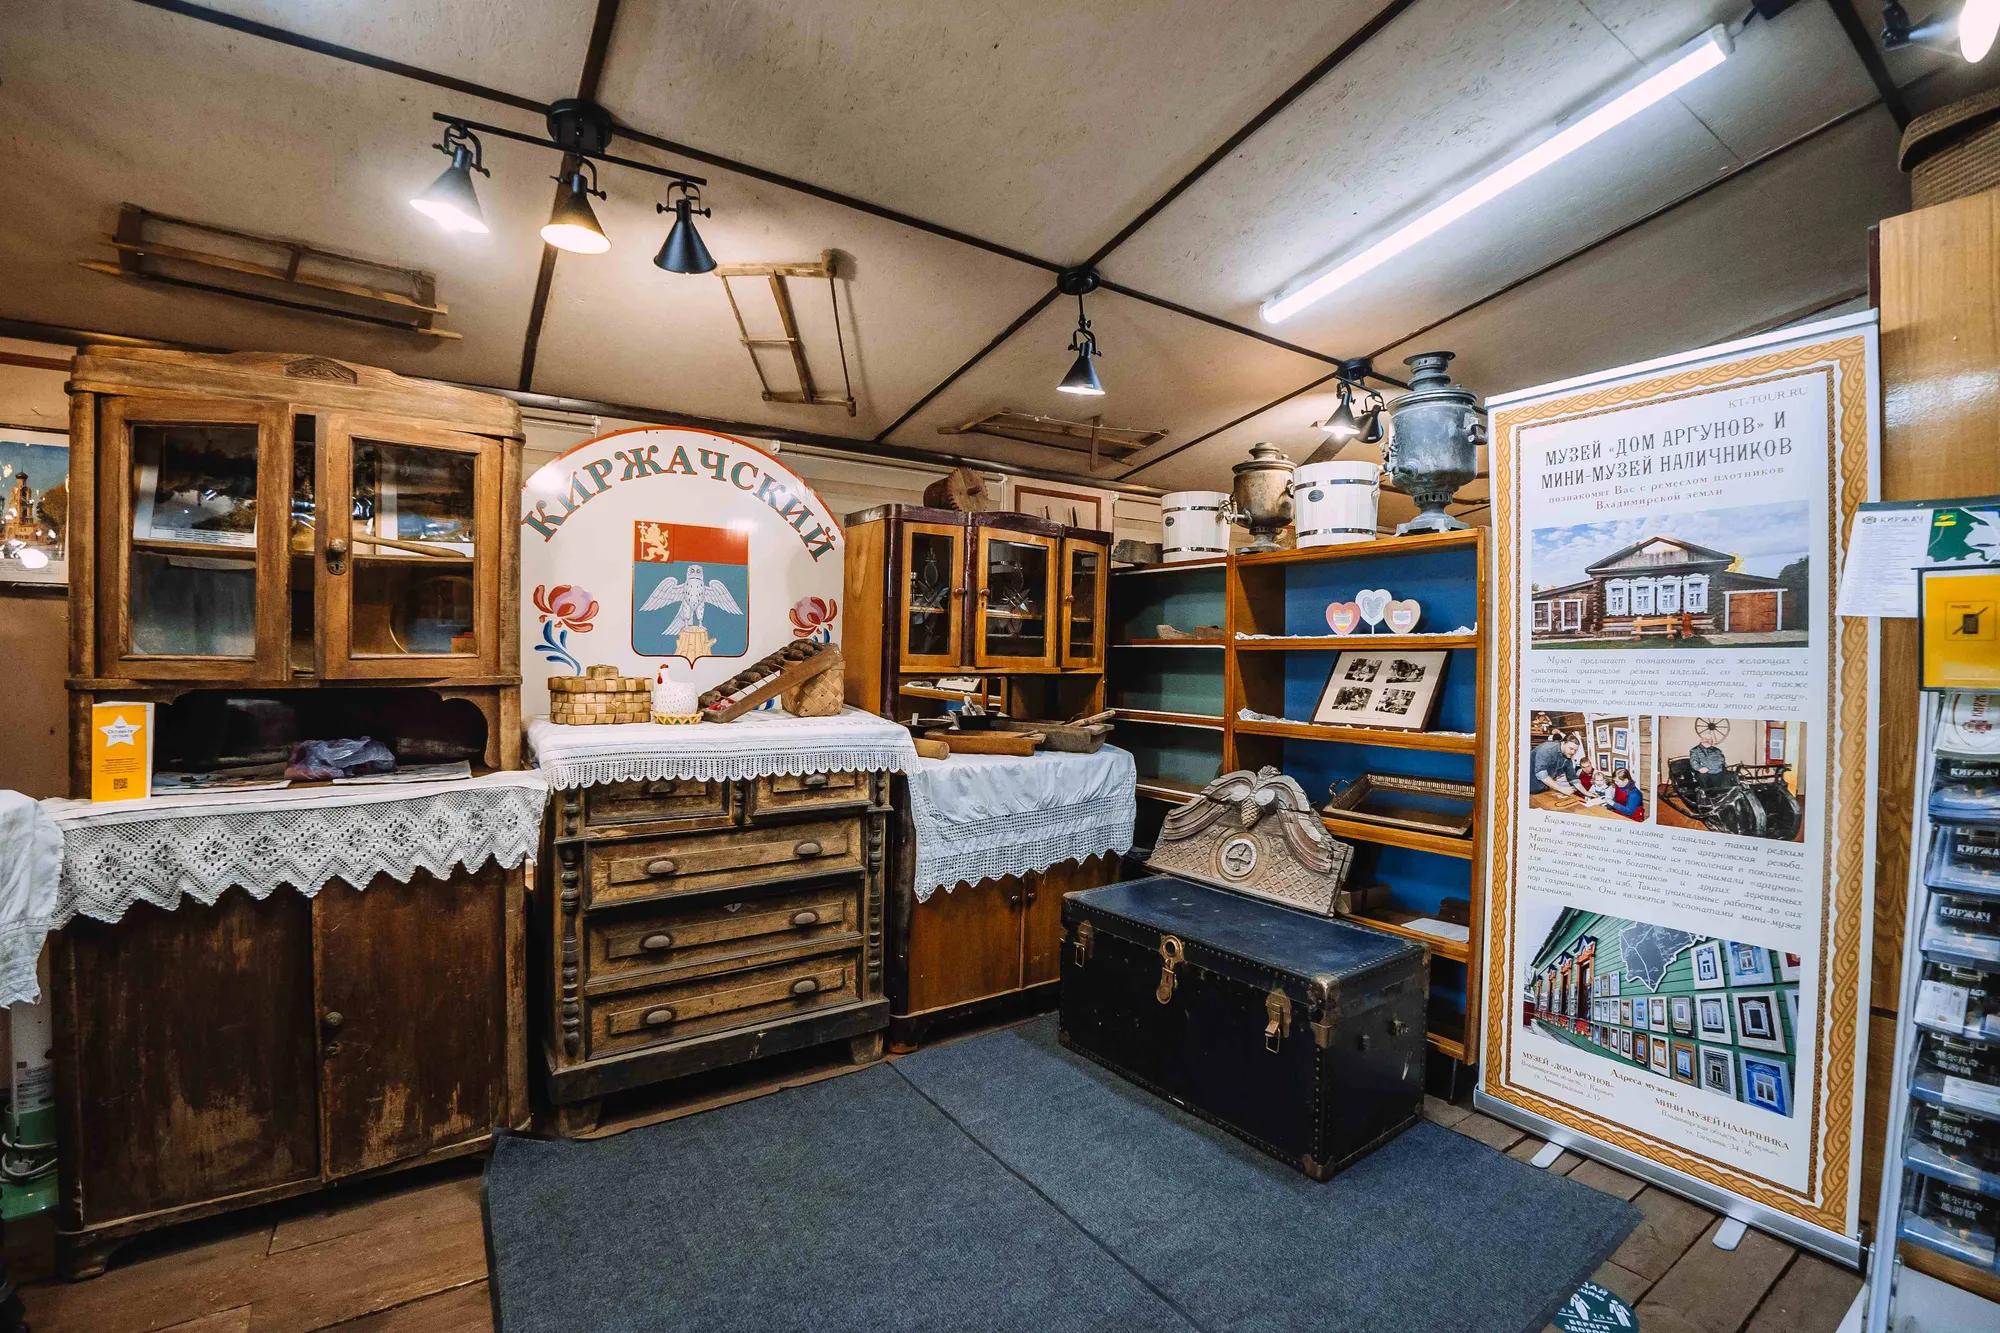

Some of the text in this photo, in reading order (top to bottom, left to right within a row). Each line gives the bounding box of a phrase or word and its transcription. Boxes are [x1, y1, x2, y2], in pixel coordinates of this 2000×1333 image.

[1545, 411, 1785, 466] МУЗЕЙ «ДОМ АРГУНОВ» И
[1541, 437, 1792, 489] МИНИ-МУЗЕЙ НАЛИЧНИКОВ
[1614, 485, 1636, 495] Вас
[521, 444, 836, 563] КИРЖАЧСКИЙ
[1957, 844, 2000, 856] КИРЖА
[1941, 906, 1991, 923] КИРЖАЧ
[1522, 1051, 1550, 1066] МУЗЕЙ
[1609, 1068, 1678, 1098] Адреса музеев:
